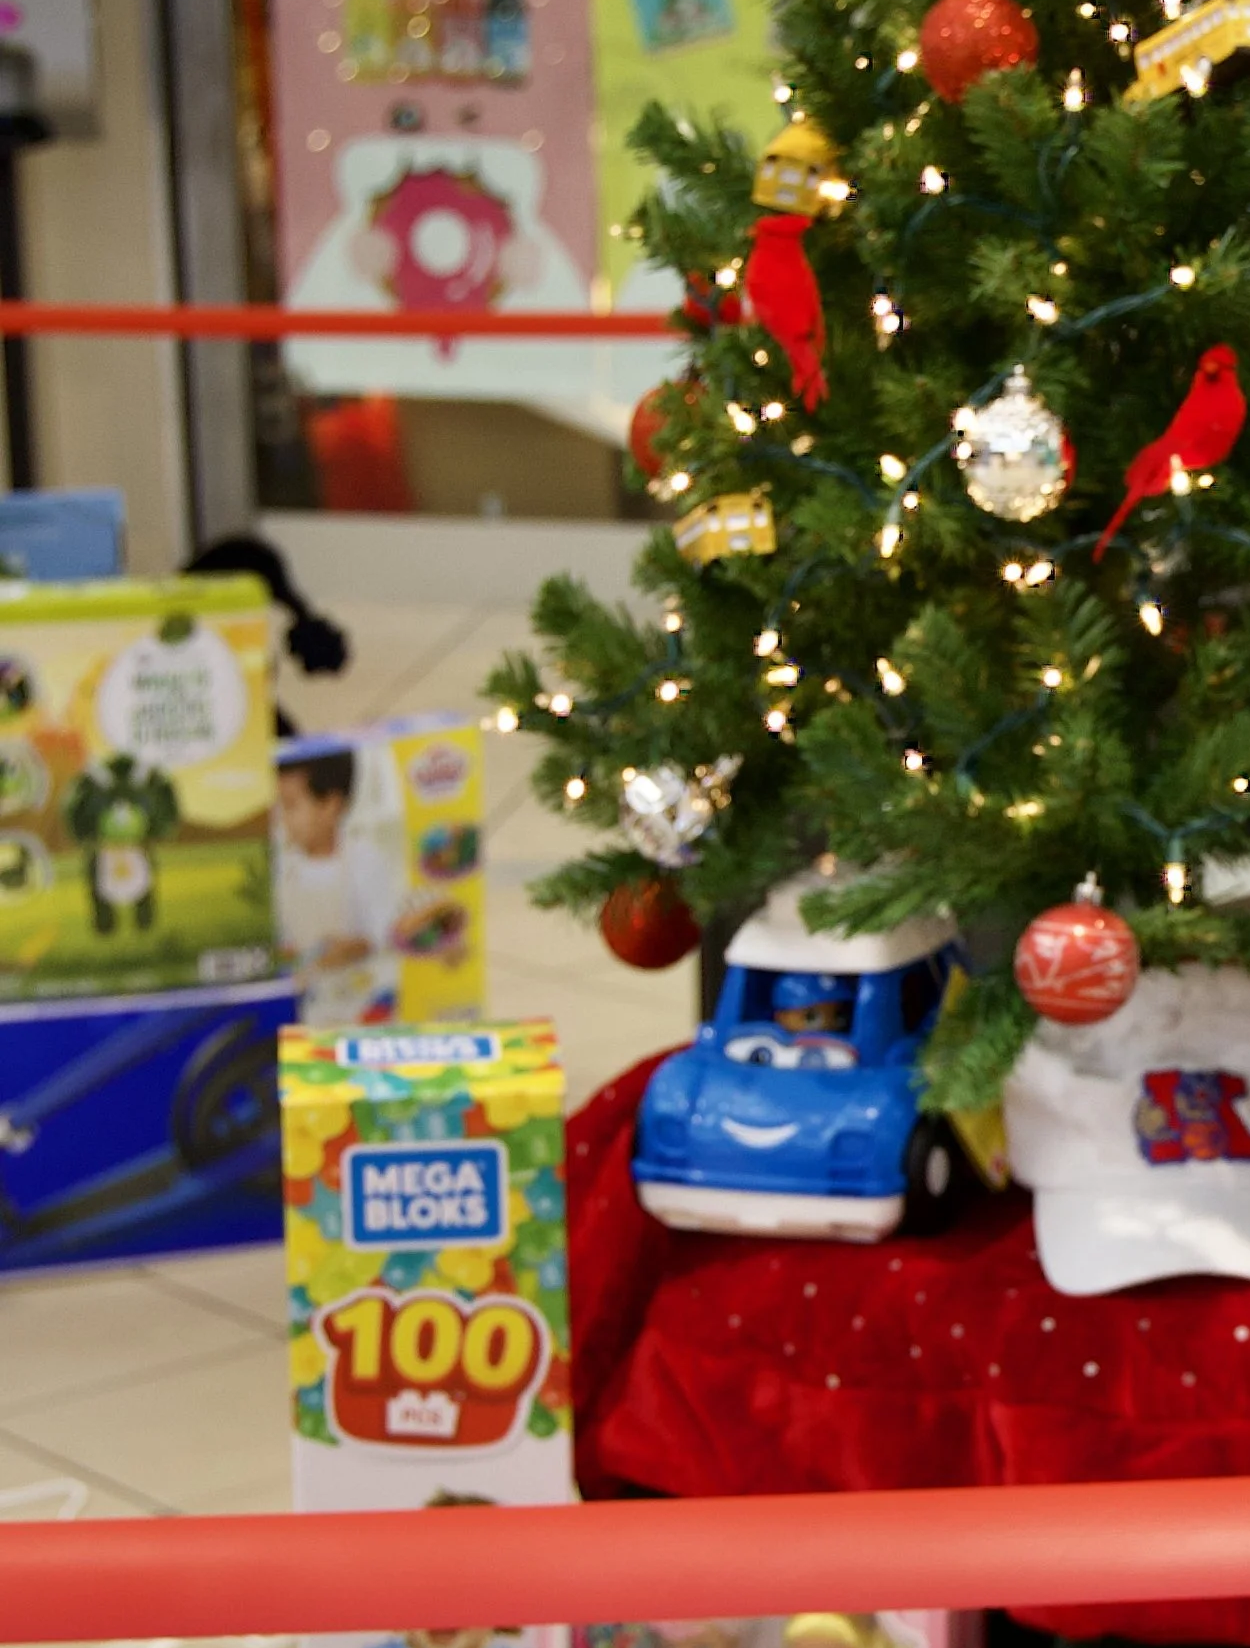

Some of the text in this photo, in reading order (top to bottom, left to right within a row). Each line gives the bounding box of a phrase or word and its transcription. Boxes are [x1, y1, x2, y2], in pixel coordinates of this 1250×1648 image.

[362, 1161, 485, 1195] MEGA
[363, 1195, 489, 1231] BLOKS
[333, 1297, 534, 1389] 100
